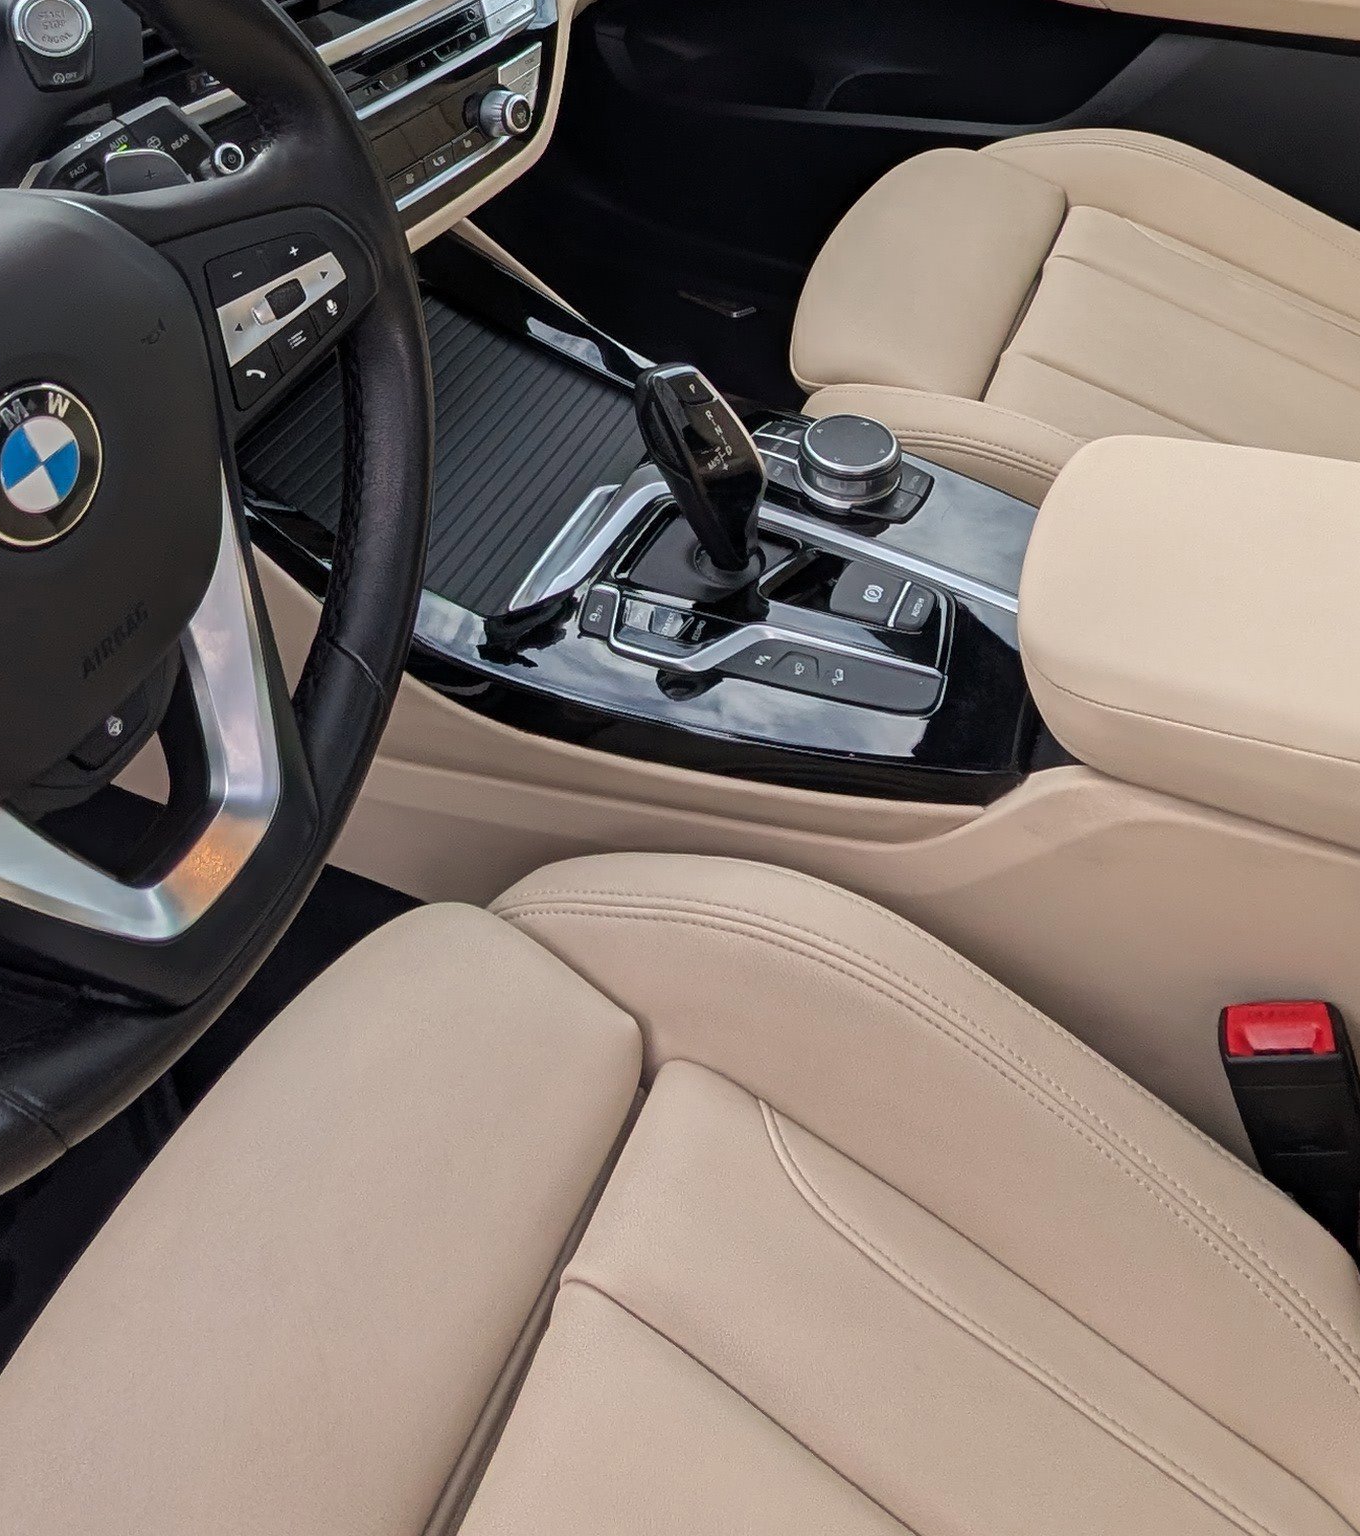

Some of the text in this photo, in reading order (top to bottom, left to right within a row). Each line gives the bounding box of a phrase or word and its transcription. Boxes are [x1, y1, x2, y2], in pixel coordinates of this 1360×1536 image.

[109, 134, 129, 152] AUTO
[170, 133, 190, 151] REAR
[69, 163, 88, 179] FAST
